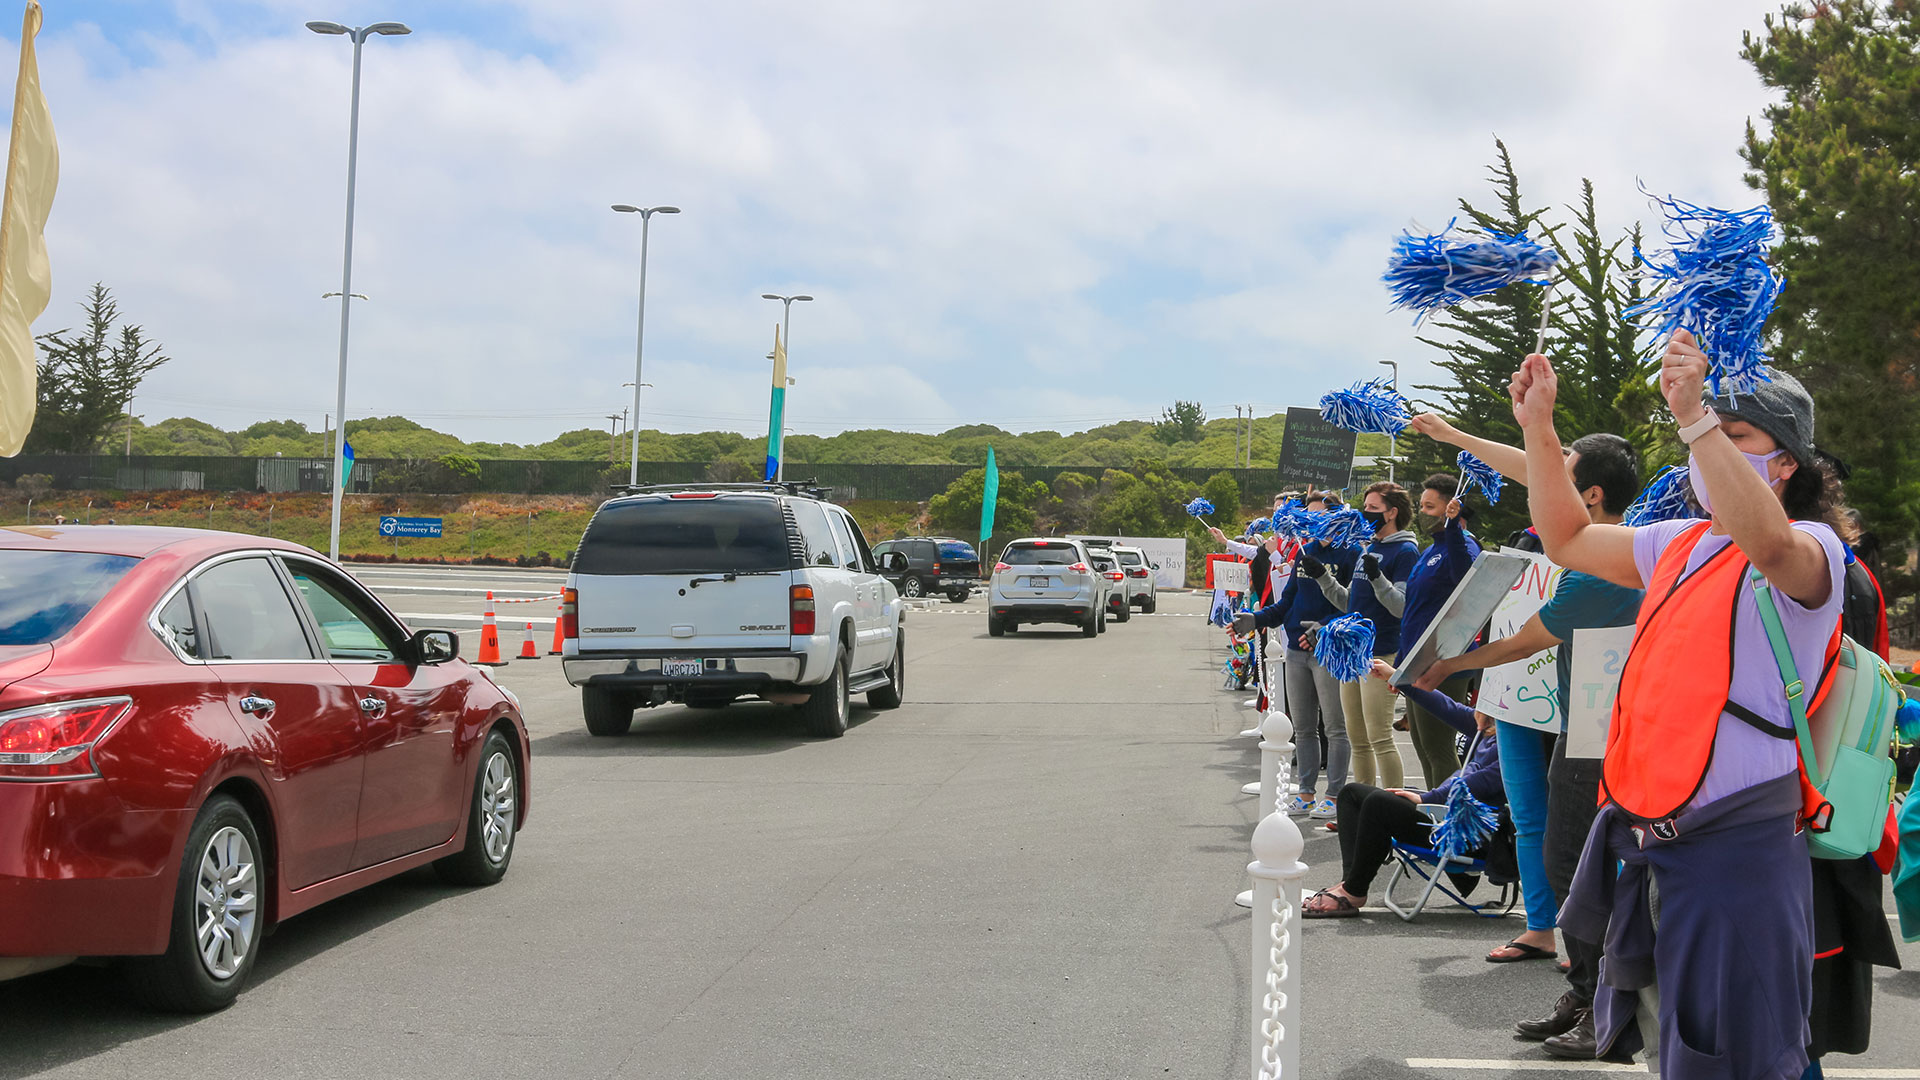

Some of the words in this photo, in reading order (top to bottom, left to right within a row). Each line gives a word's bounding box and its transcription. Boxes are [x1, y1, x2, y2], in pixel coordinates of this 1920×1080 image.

[397, 525, 428, 535] Monterey
[430, 527, 442, 535] Bay
[1166, 557, 1183, 571] Bay
[1527, 648, 1557, 675] and
